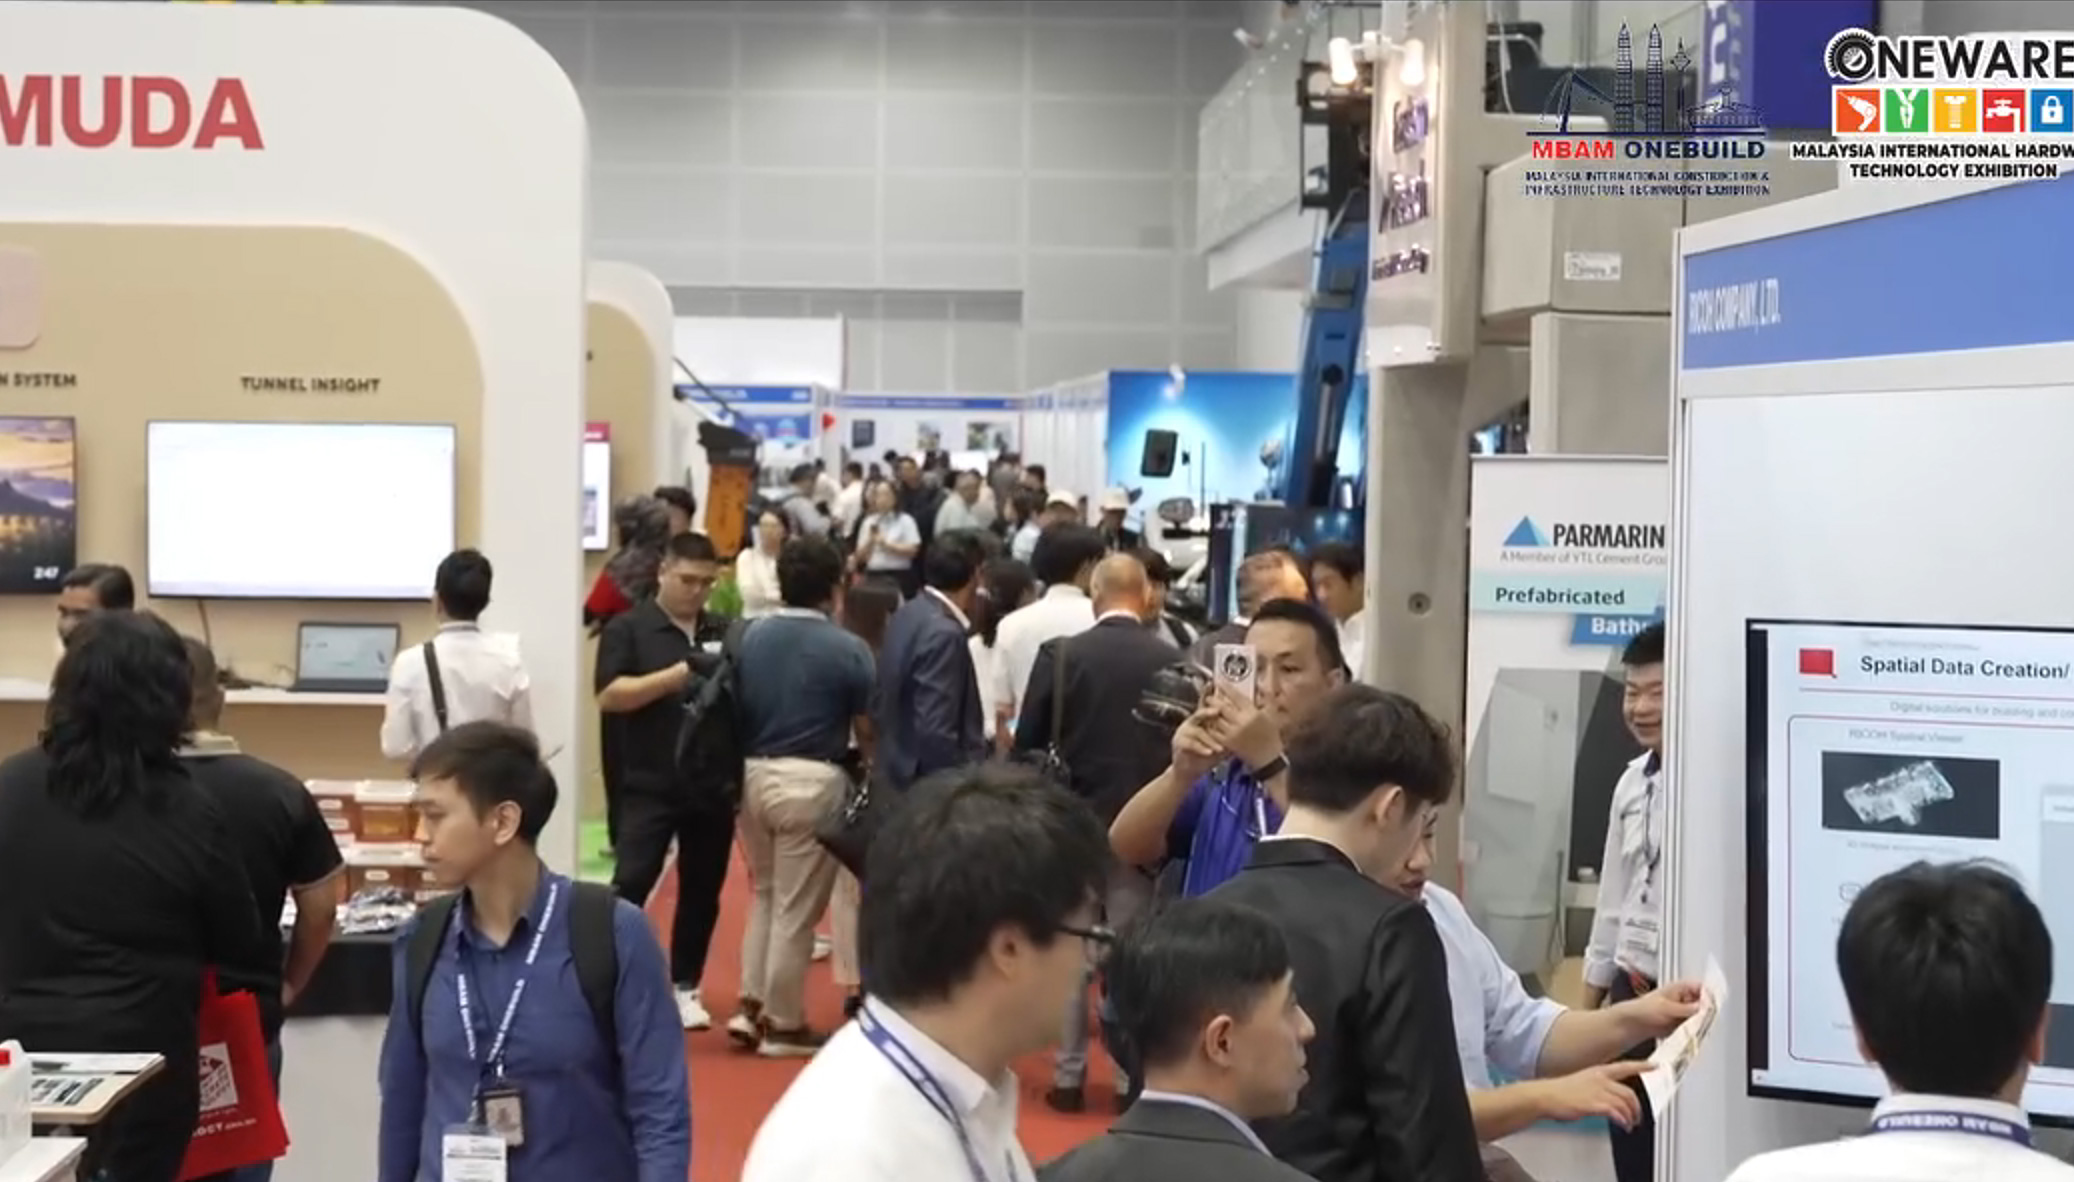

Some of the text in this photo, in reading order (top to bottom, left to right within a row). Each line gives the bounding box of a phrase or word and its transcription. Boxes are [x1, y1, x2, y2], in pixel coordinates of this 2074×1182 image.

[0, 73, 265, 150] MUDA
[14, 373, 77, 388] SYSTEM
[240, 377, 381, 393] TUNNEL INSIGHT
[1553, 524, 1665, 548] PARMARIN
[1495, 587, 1625, 605] Prefabricated
[1860, 655, 2070, 679] Spatial Data Creation/
